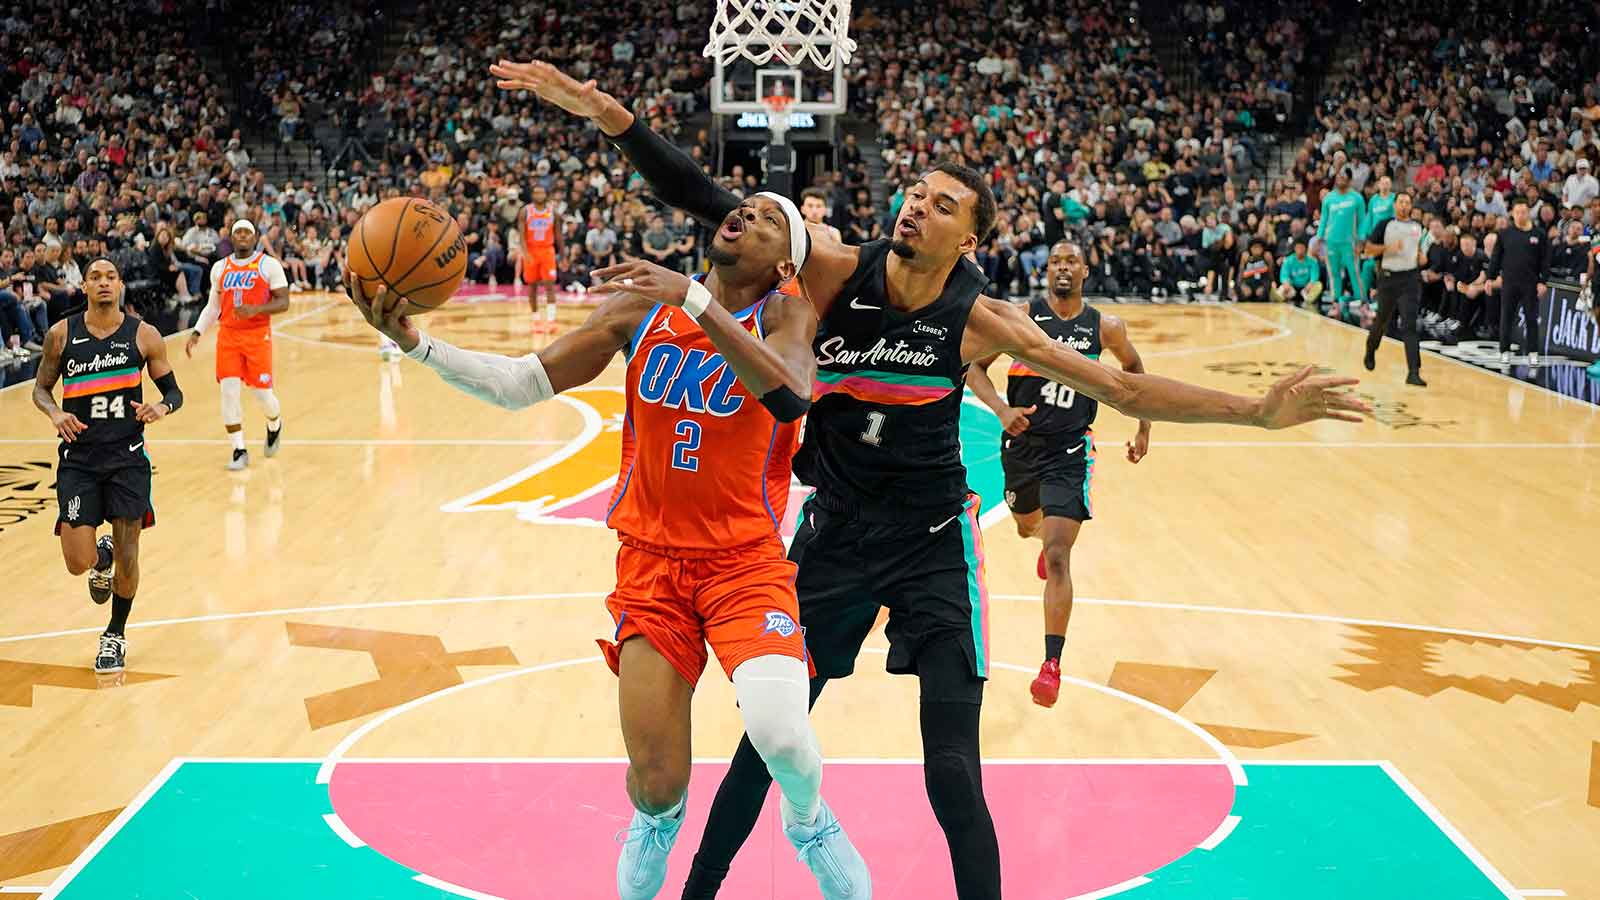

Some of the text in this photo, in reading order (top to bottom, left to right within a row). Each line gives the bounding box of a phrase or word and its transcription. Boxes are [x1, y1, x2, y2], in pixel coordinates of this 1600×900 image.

[223, 270, 258, 290] OKC
[917, 323, 943, 336] LEDGER
[1552, 298, 1589, 351] JACK
[67, 352, 128, 377] San Antonio
[816, 335, 939, 367] San Antonio
[638, 342, 745, 417] OKC
[90, 396, 126, 419] 24
[1040, 381, 1076, 408] 40
[859, 410, 887, 447] 1
[671, 419, 702, 473] 2
